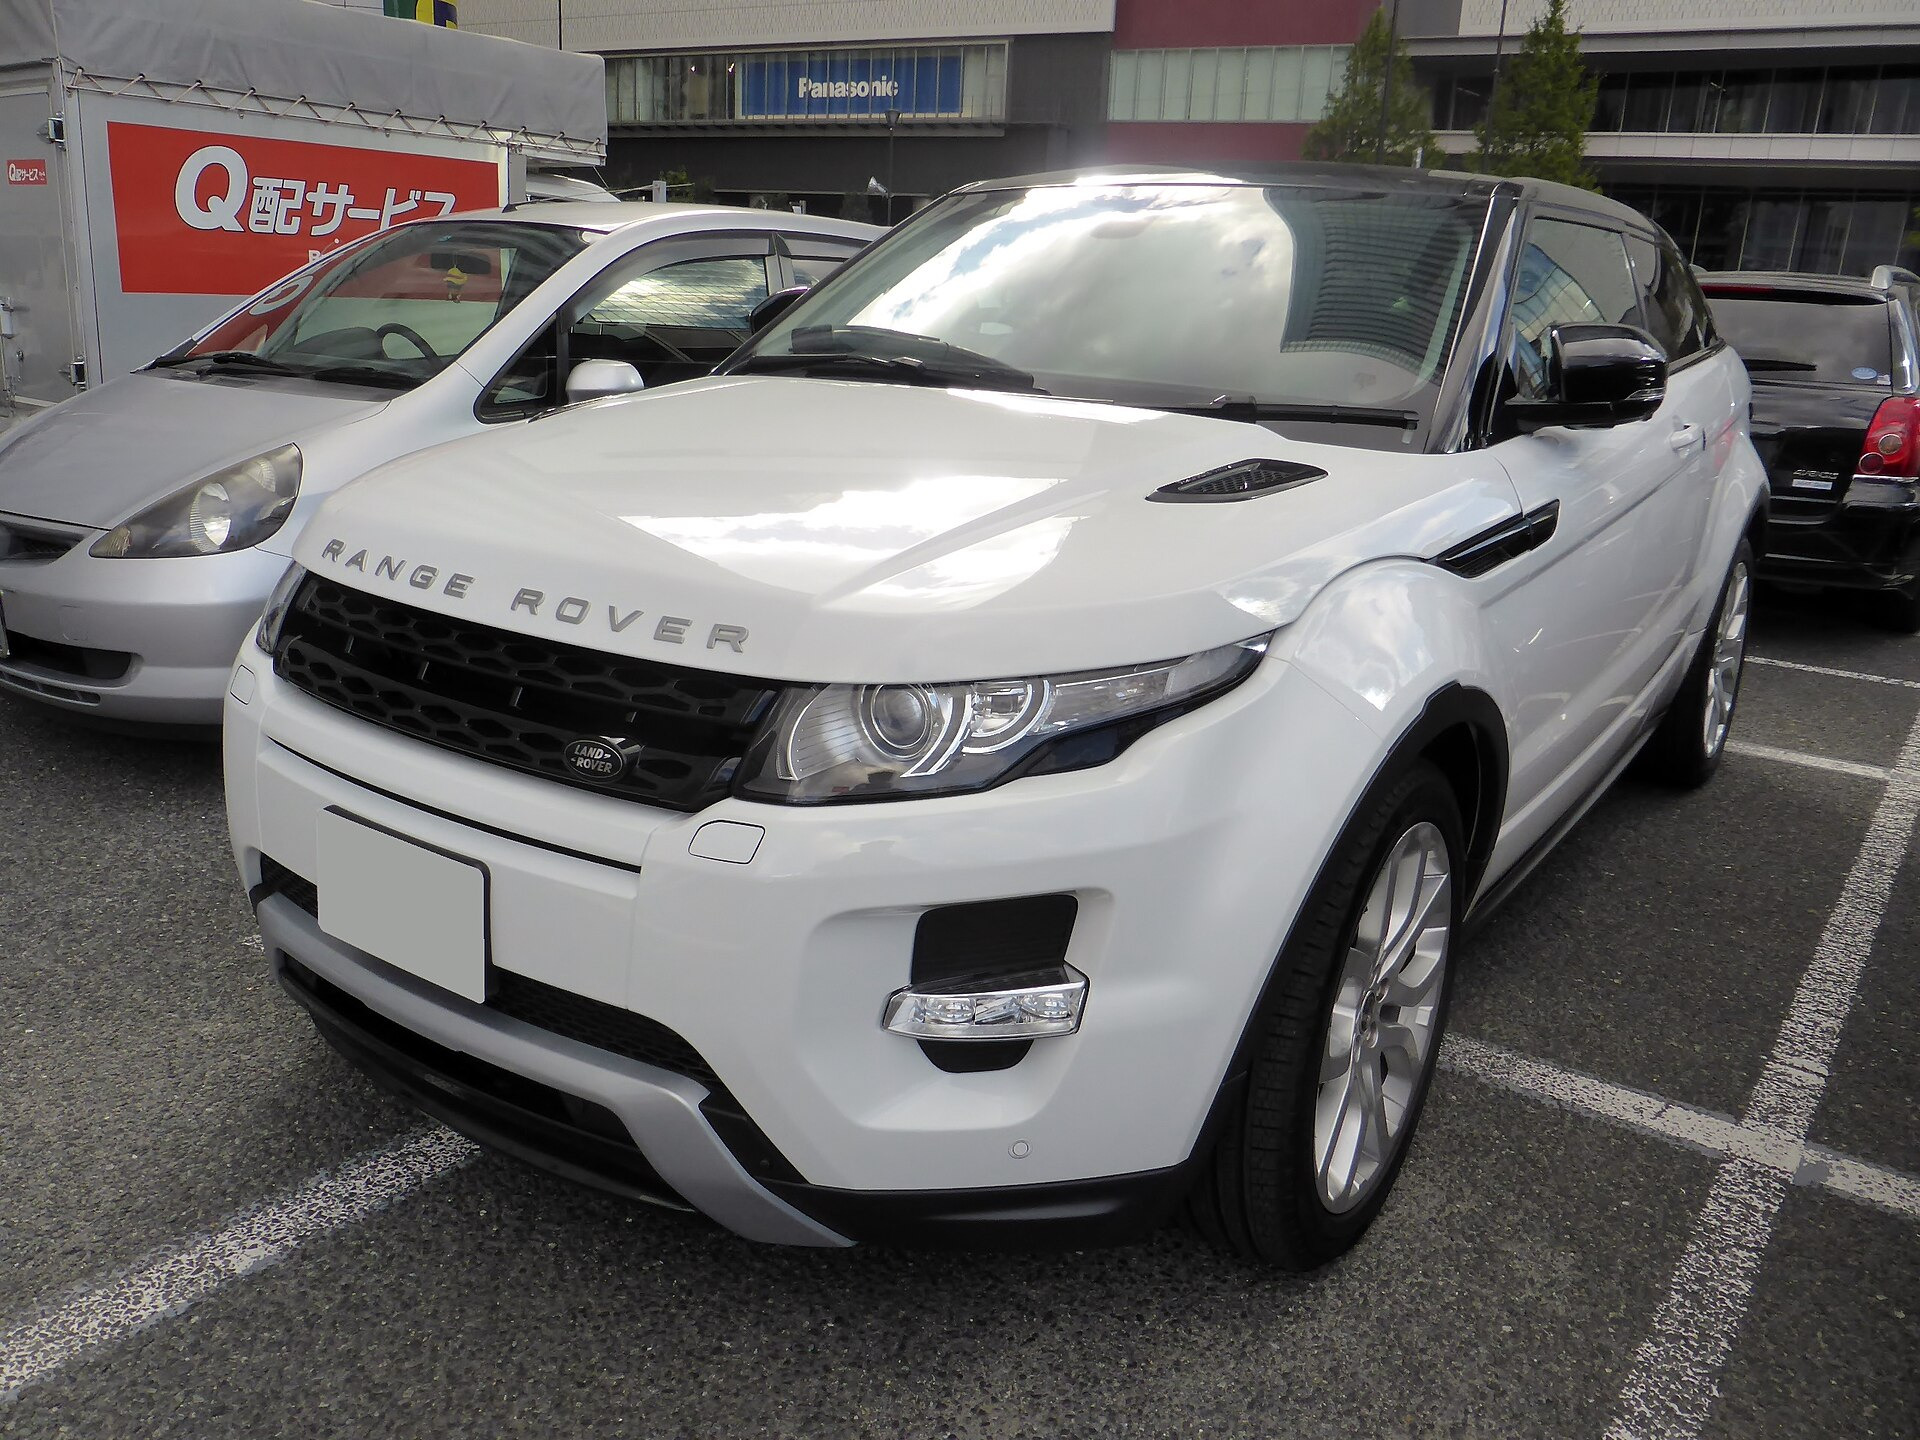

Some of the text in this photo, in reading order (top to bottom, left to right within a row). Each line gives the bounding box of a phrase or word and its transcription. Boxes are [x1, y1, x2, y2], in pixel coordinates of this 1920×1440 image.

[798, 75, 899, 98] Panasonic
[321, 538, 750, 655] RANGE ROVER
[574, 744, 605, 760] LAND
[576, 757, 613, 774] ROVER
